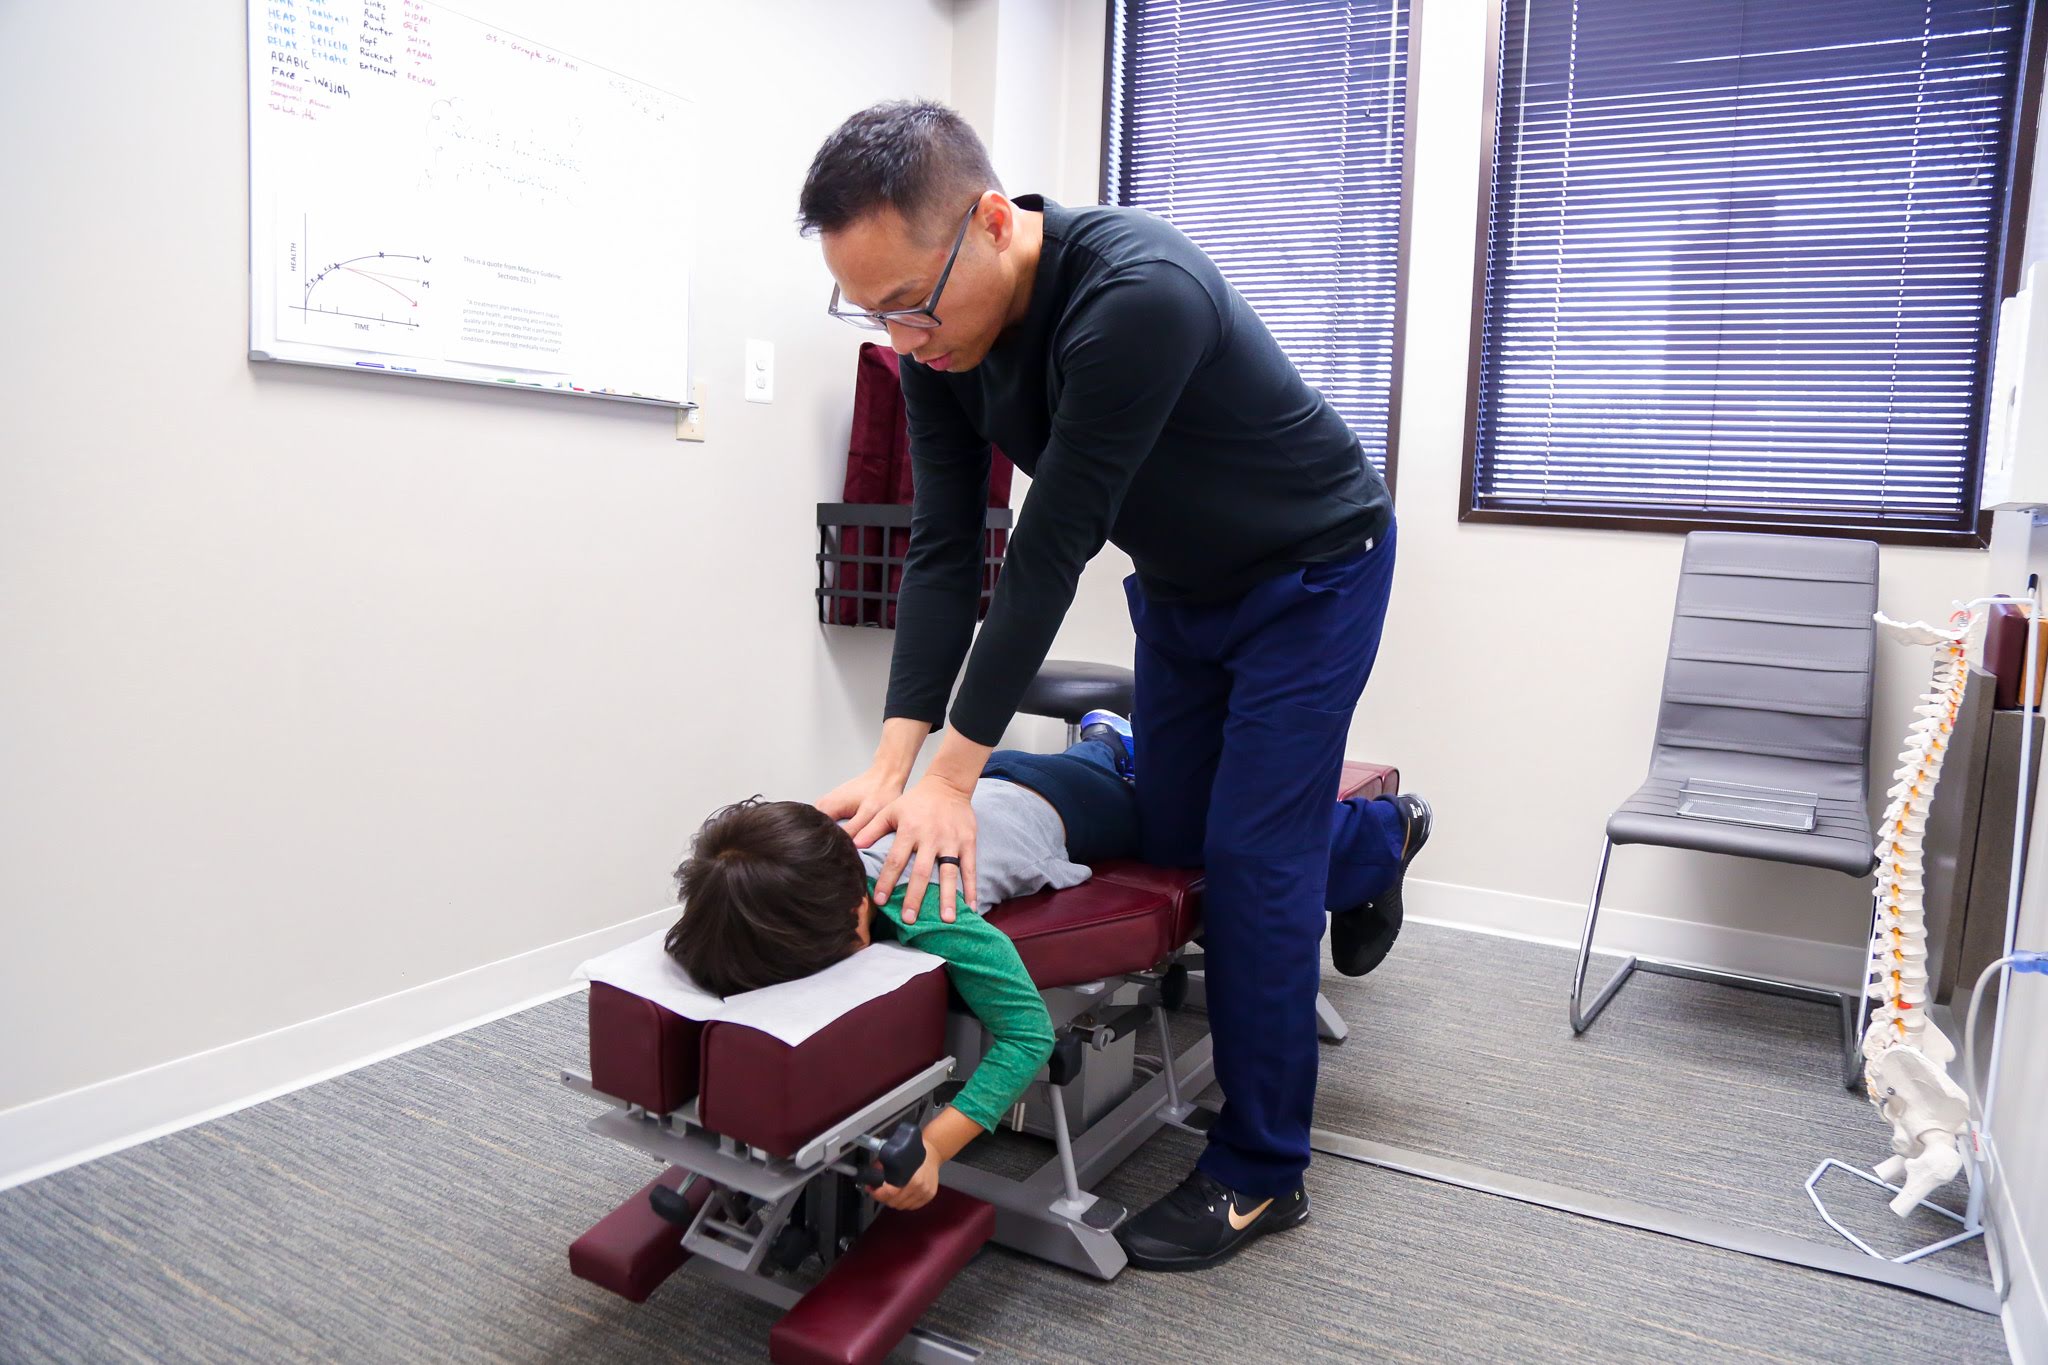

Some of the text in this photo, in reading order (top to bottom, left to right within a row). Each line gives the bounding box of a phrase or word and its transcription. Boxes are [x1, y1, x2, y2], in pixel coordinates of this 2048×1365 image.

[268, 8, 296, 22] HEAD
[364, 8, 386, 24] Rauf
[364, 20, 393, 36] Runter
[360, 34, 377, 46] Kopf
[271, 51, 310, 69] ARABIC
[422, 255, 432, 264] W
[463, 256, 475, 264] This
